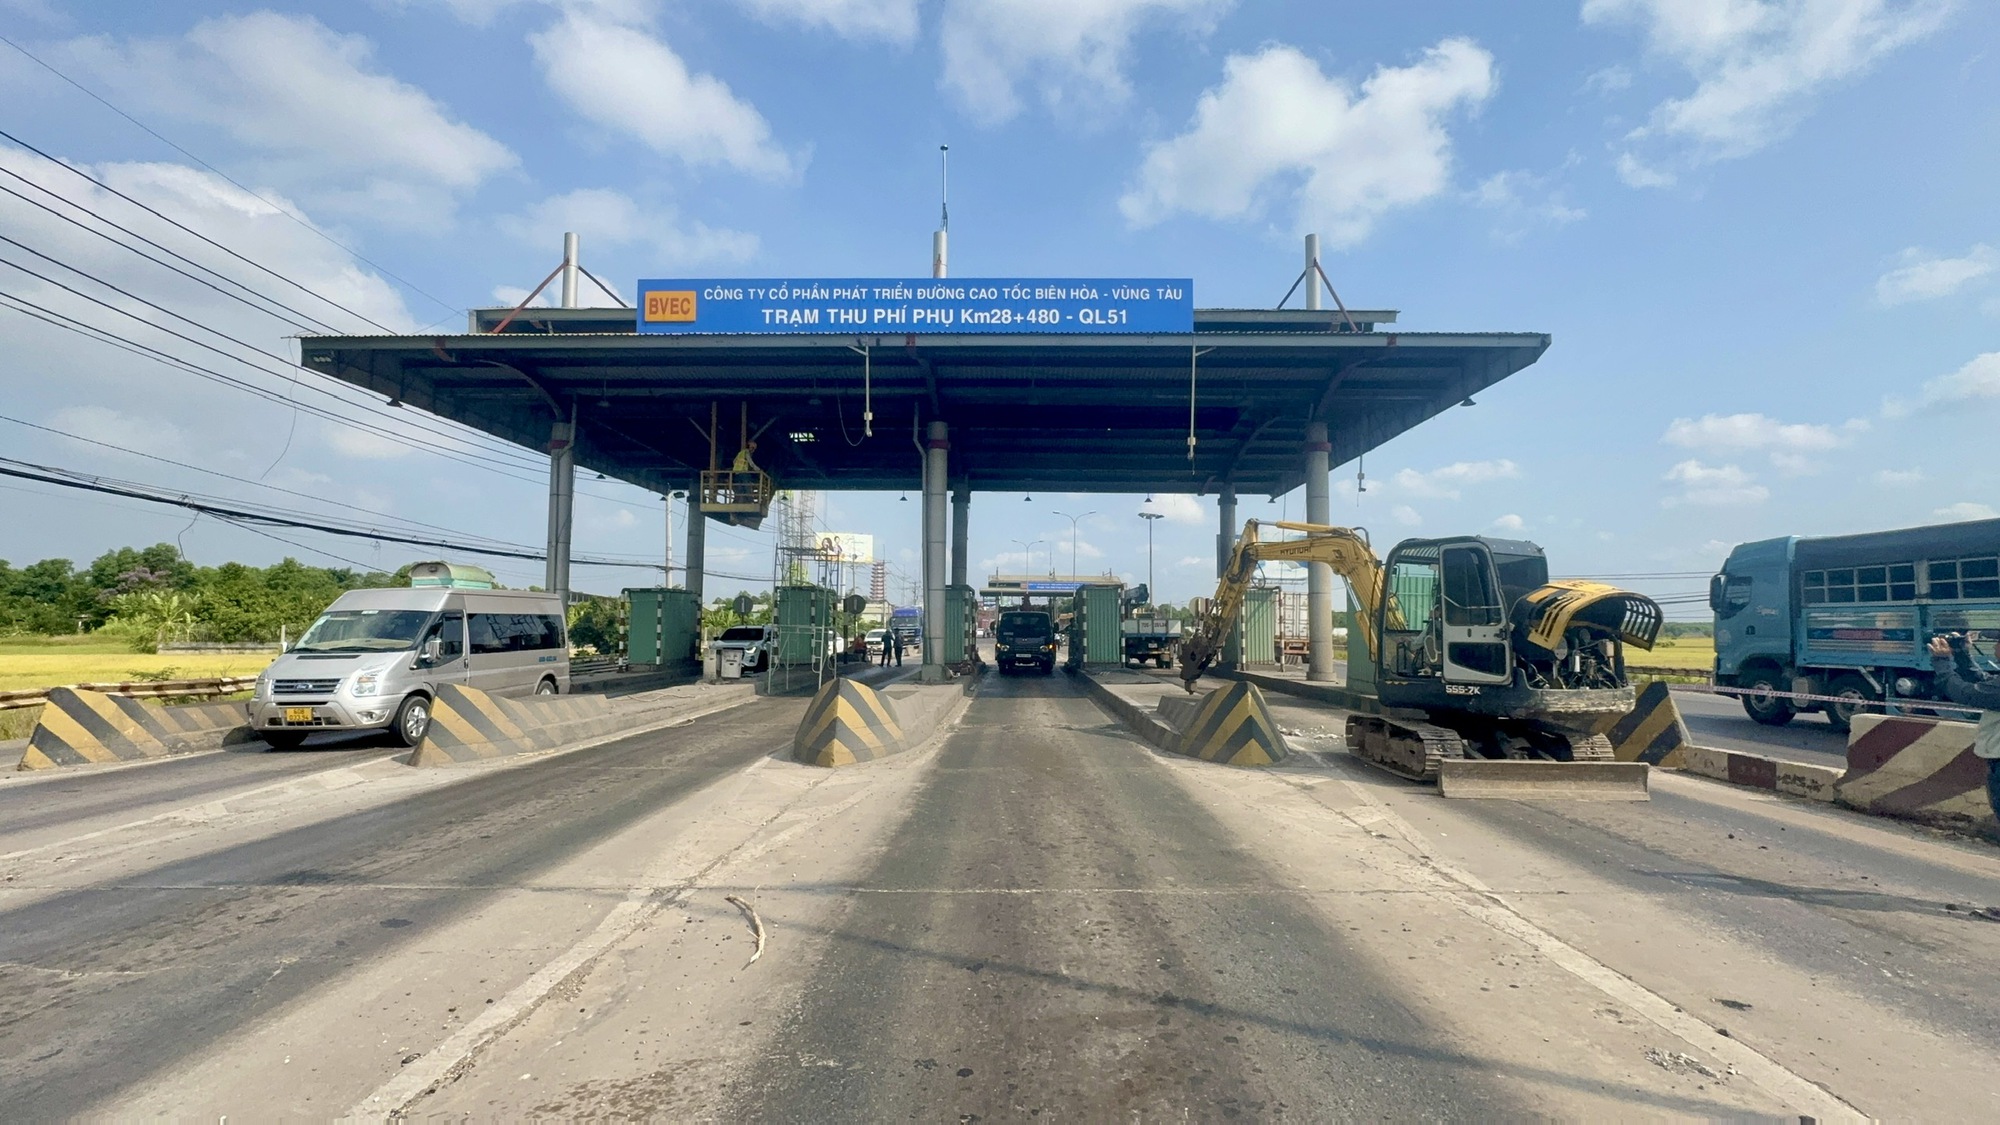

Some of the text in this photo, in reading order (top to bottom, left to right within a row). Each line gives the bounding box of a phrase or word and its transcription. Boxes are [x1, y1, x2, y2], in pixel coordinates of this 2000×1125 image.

[703, 285, 743, 300] CÔNG
[748, 288, 765, 300] TY
[769, 281, 789, 300] CỔ
[792, 282, 830, 300] PHẦN
[833, 284, 869, 300] PHÁT
[873, 281, 913, 300] TRIỂN
[917, 284, 965, 300] ĐƯỜNG
[969, 287, 998, 300] CAO
[1002, 283, 1031, 300] TỐC
[1035, 284, 1066, 300] BIÊN
[1070, 284, 1099, 300] HÒA
[1112, 284, 1150, 300] VŨNG
[1156, 285, 1183, 300] TÀU
[649, 297, 691, 315] BVEC
[762, 308, 819, 328] TRẠM
[827, 308, 867, 324] THU
[874, 305, 906, 324] PHÍ
[913, 308, 954, 328] PHỤ
[961, 308, 1060, 324] Km28+480
[1079, 308, 1127, 325] QL51
